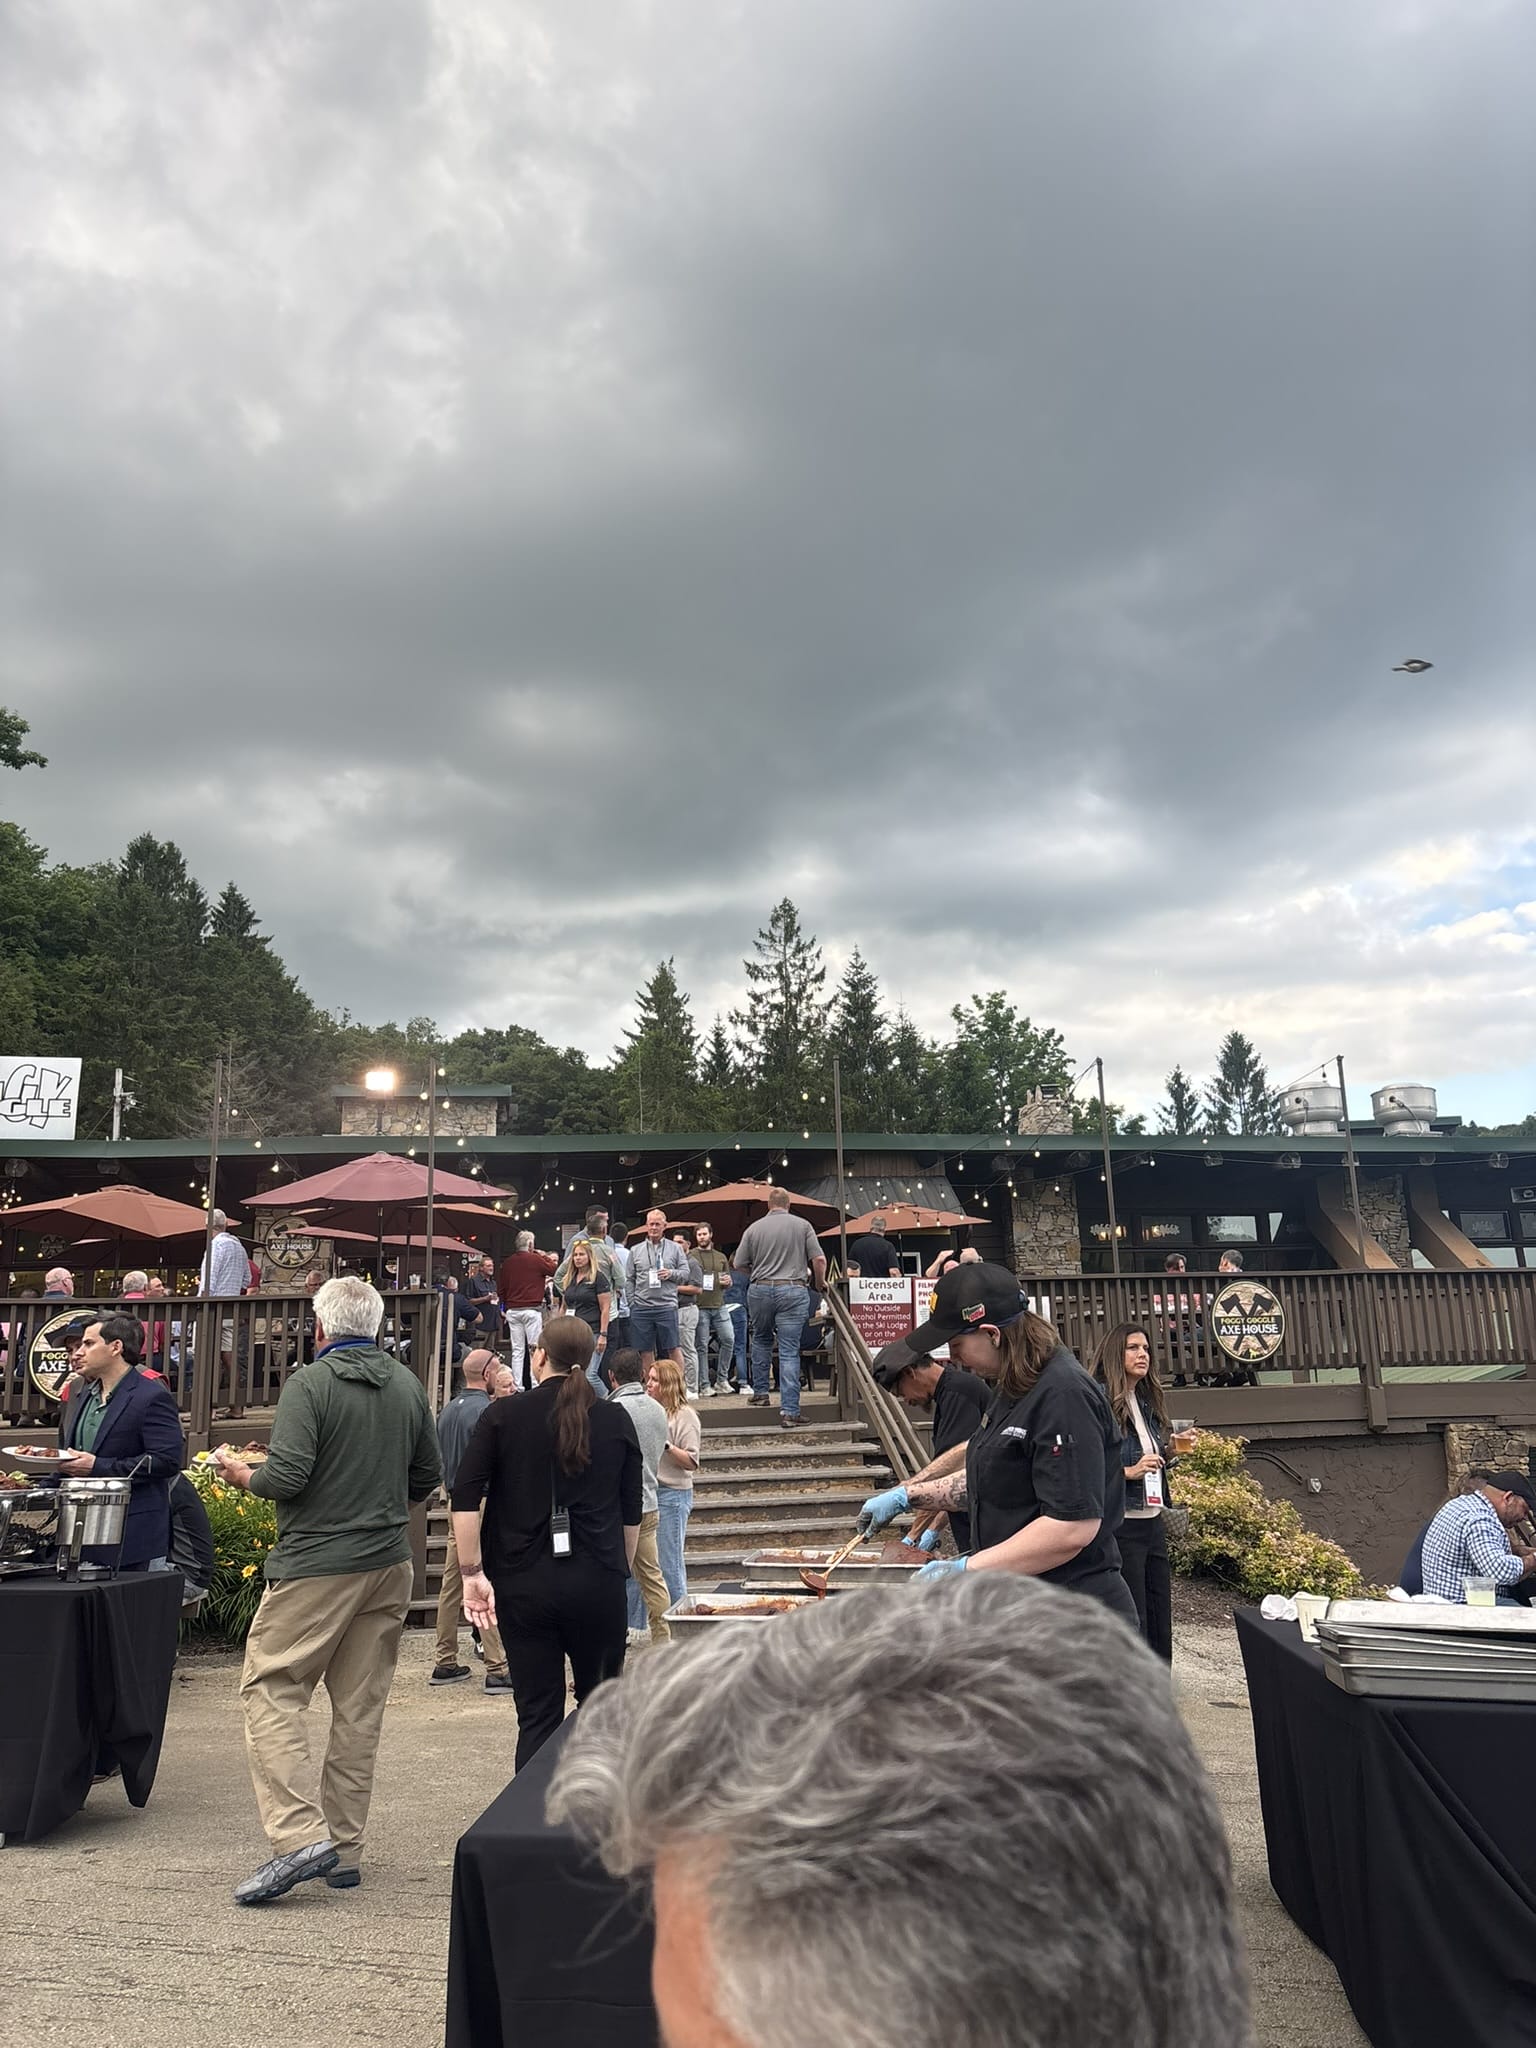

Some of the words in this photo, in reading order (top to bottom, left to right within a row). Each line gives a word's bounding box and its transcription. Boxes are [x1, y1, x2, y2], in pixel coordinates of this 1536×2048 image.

[858, 1279, 905, 1290] Licensed
[868, 1291, 893, 1301] Area
[862, 1304, 873, 1312] No
[874, 1304, 901, 1312] Outside
[851, 1313, 876, 1321] Alcohol
[877, 1313, 911, 1321] Permitted
[1220, 1317, 1245, 1325] FOGGY
[1246, 1316, 1276, 1324] GOGGLE
[862, 1321, 875, 1329] the
[875, 1321, 886, 1329] Ski
[886, 1321, 908, 1331] Lodge
[1220, 1325, 1241, 1335] AXE
[1242, 1323, 1279, 1334] HOUSE
[884, 1330, 896, 1338] the
[41, 1352, 69, 1361] FOGG
[38, 1360, 66, 1372] AXE
